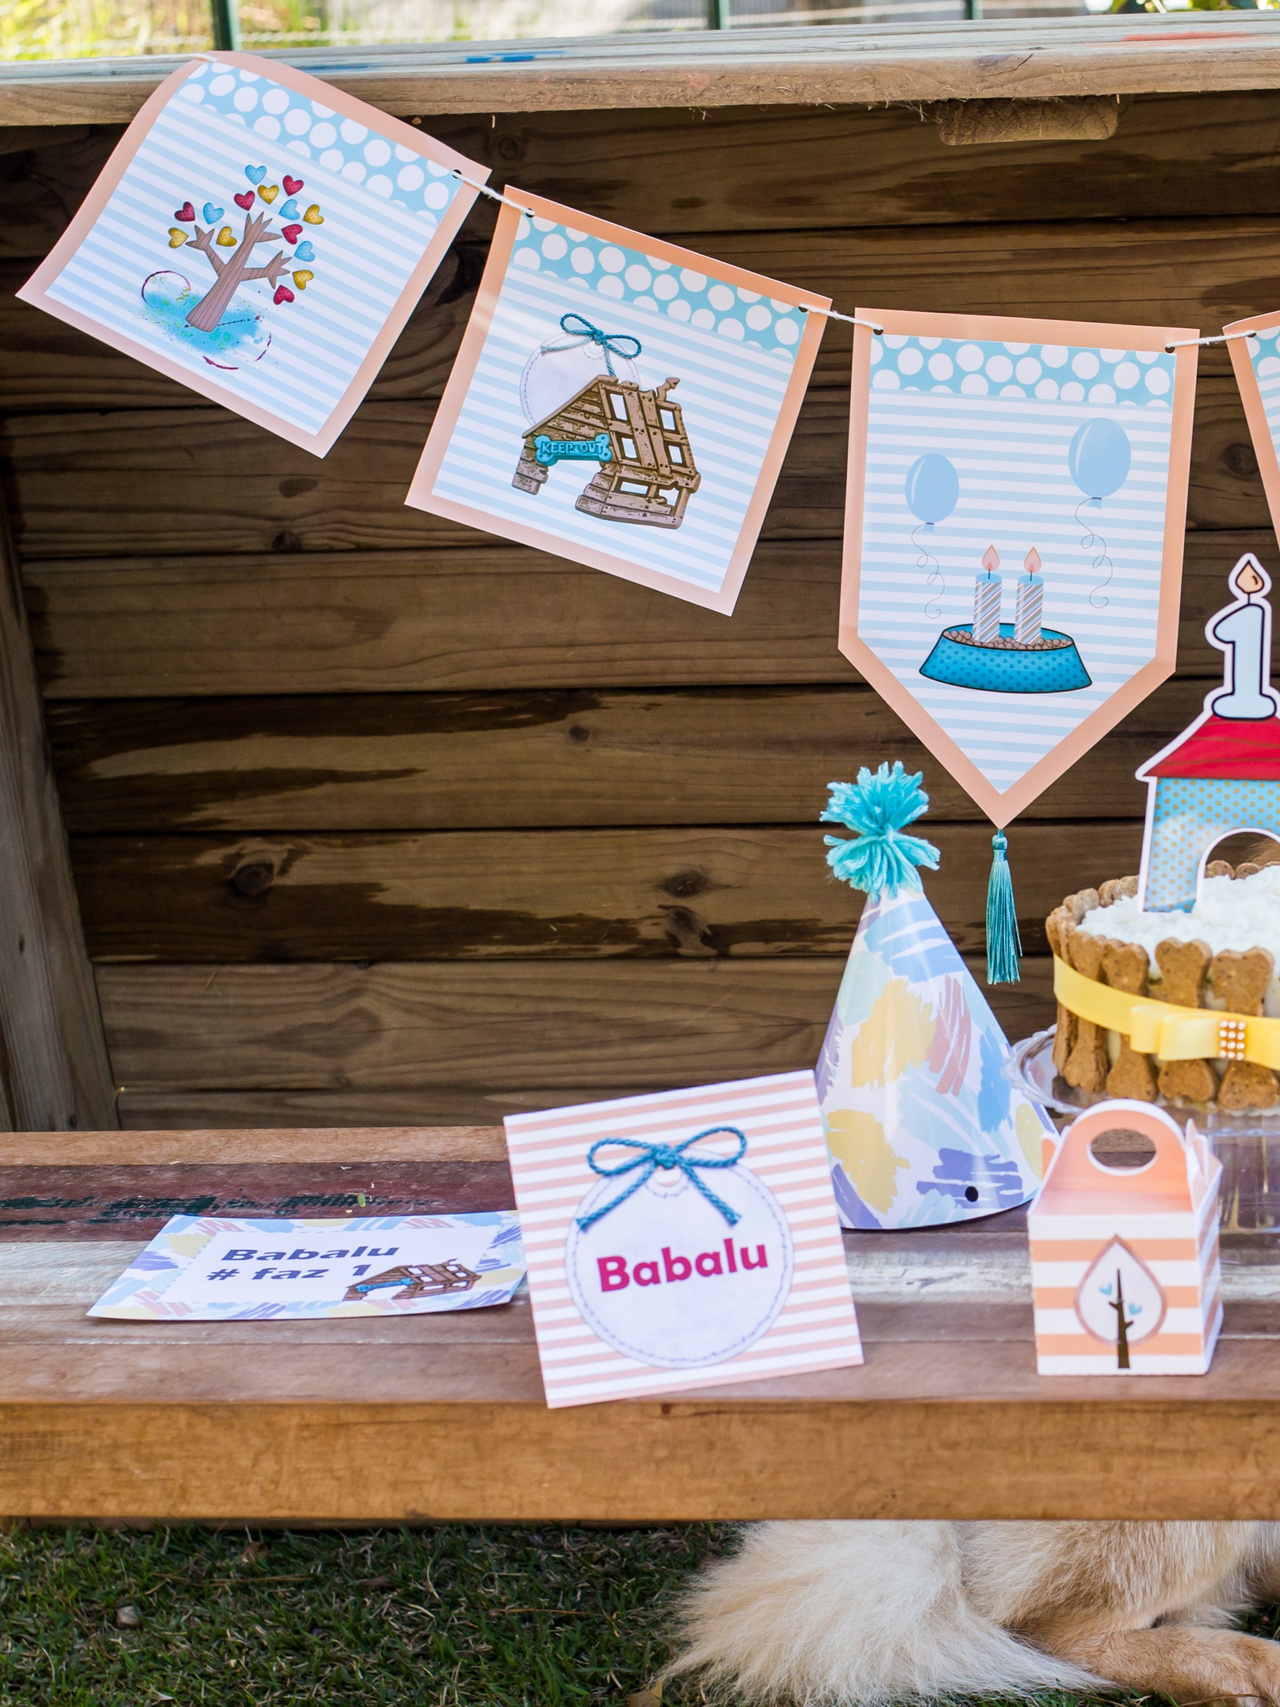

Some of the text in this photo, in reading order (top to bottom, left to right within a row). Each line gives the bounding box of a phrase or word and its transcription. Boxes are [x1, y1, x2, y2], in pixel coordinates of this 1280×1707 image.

[541, 442, 574, 454] KEEP
[221, 1245, 400, 1261] Babalu
[251, 1267, 330, 1280] faz
[352, 1264, 372, 1277] 1
[596, 1238, 769, 1293] Babalu
